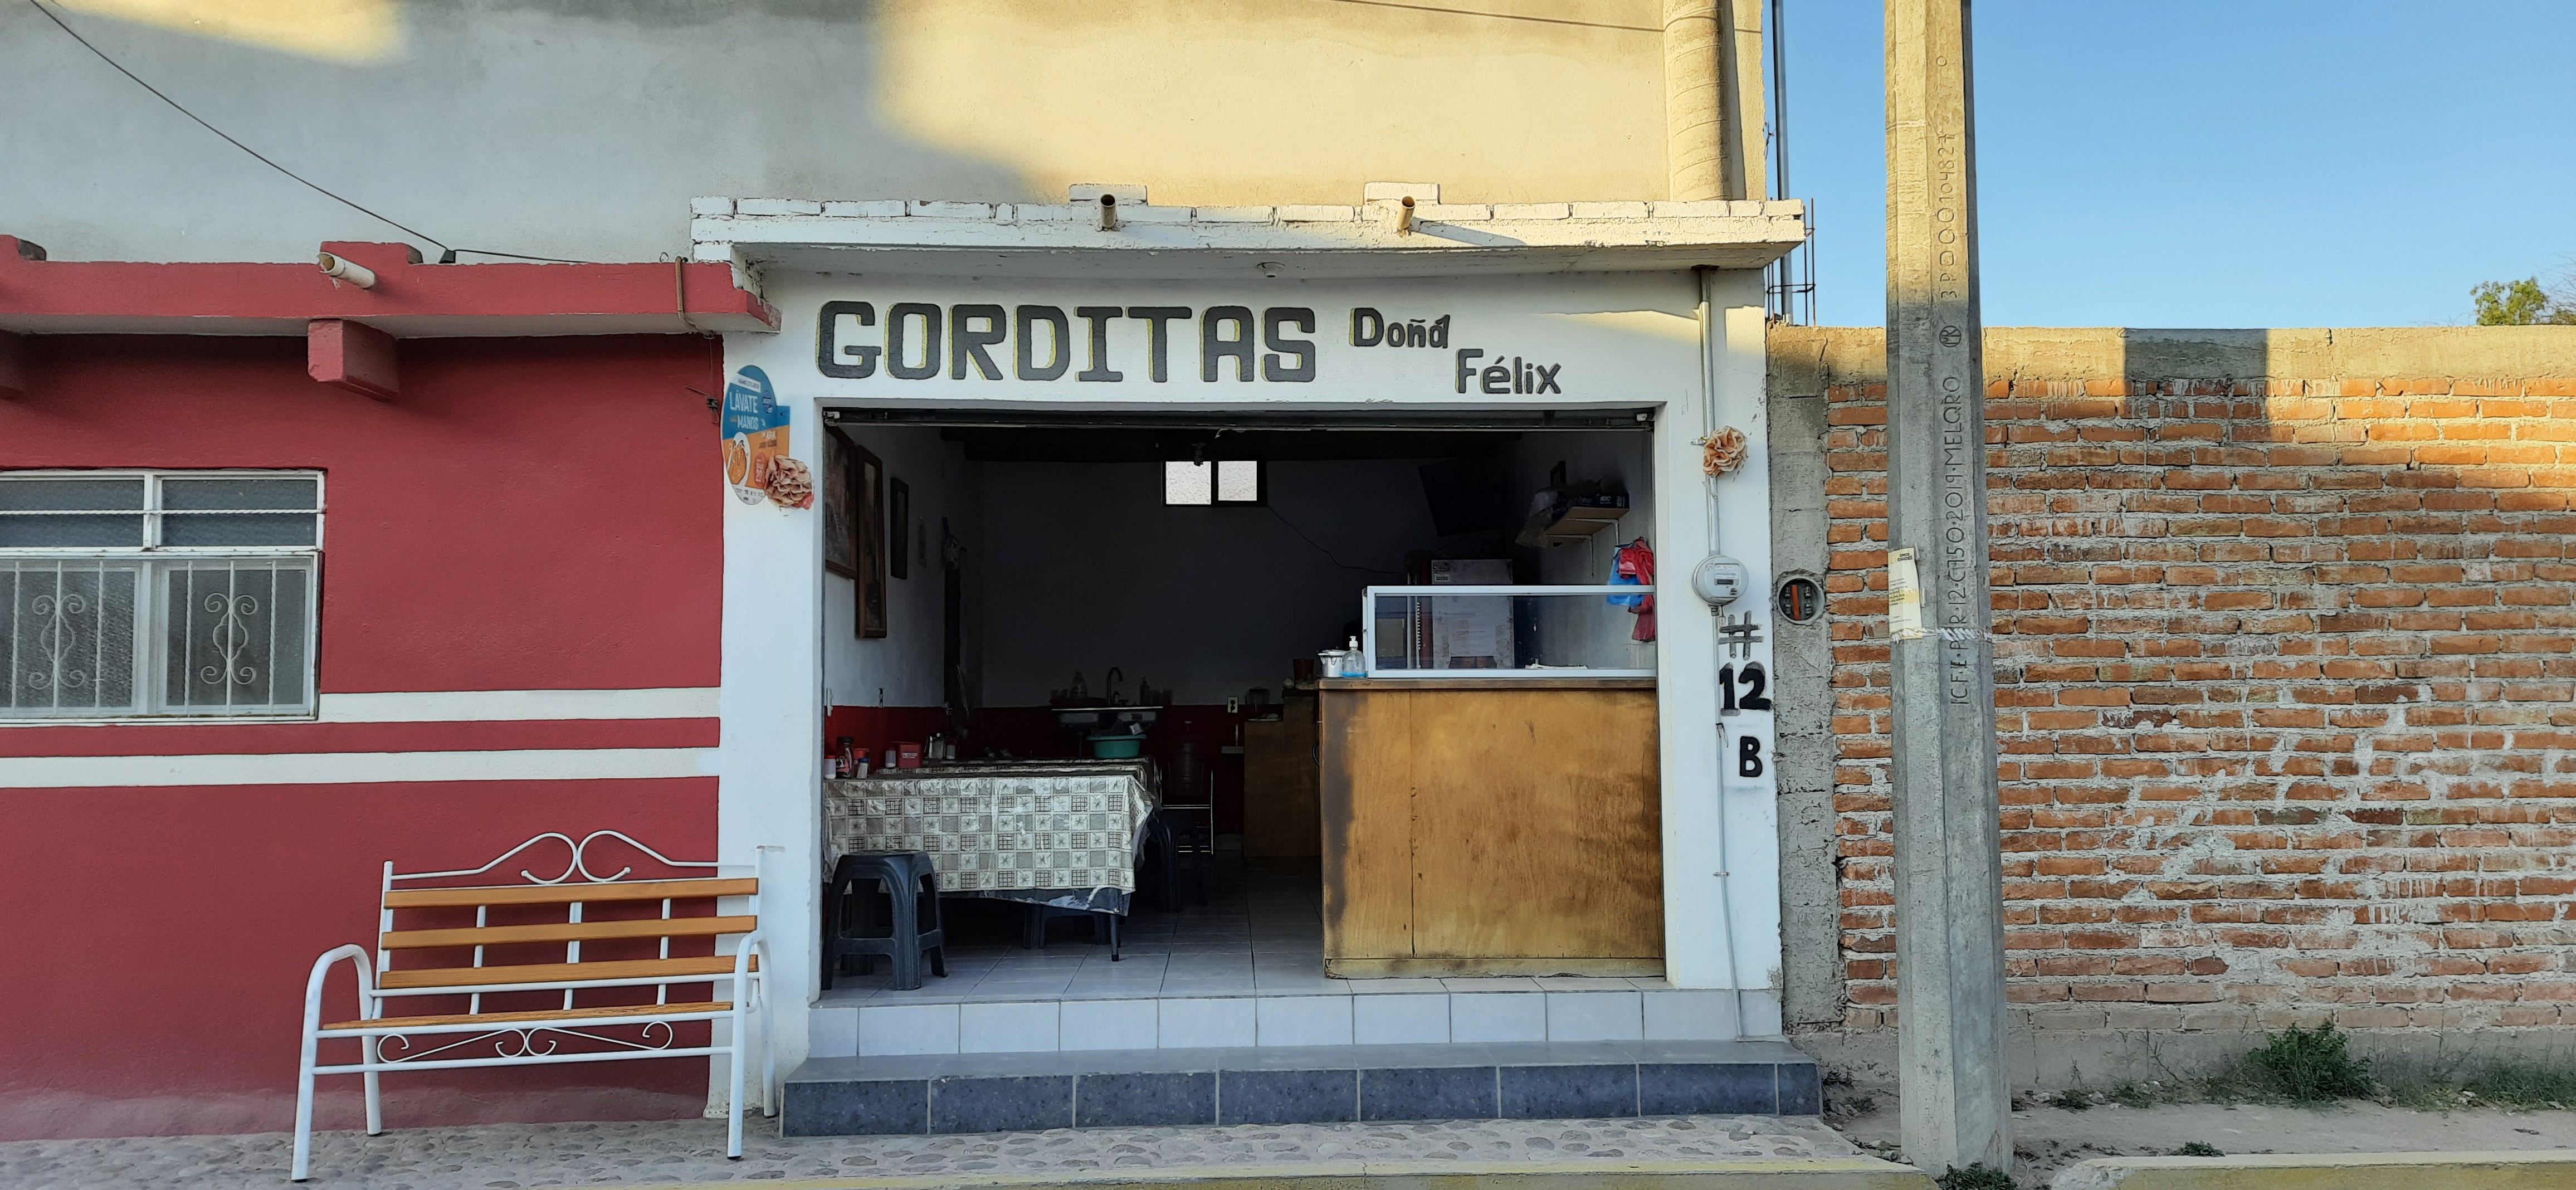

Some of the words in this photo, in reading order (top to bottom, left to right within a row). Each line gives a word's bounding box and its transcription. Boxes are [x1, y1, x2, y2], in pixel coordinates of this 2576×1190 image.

[815, 301, 1316, 383] GORDITAS
[1455, 348, 1562, 394] Félix
[729, 389, 758, 413] LÁVATE
[736, 414, 758, 430] MANOS
[1719, 660, 1774, 716] 12
[1739, 735, 1763, 778] B
